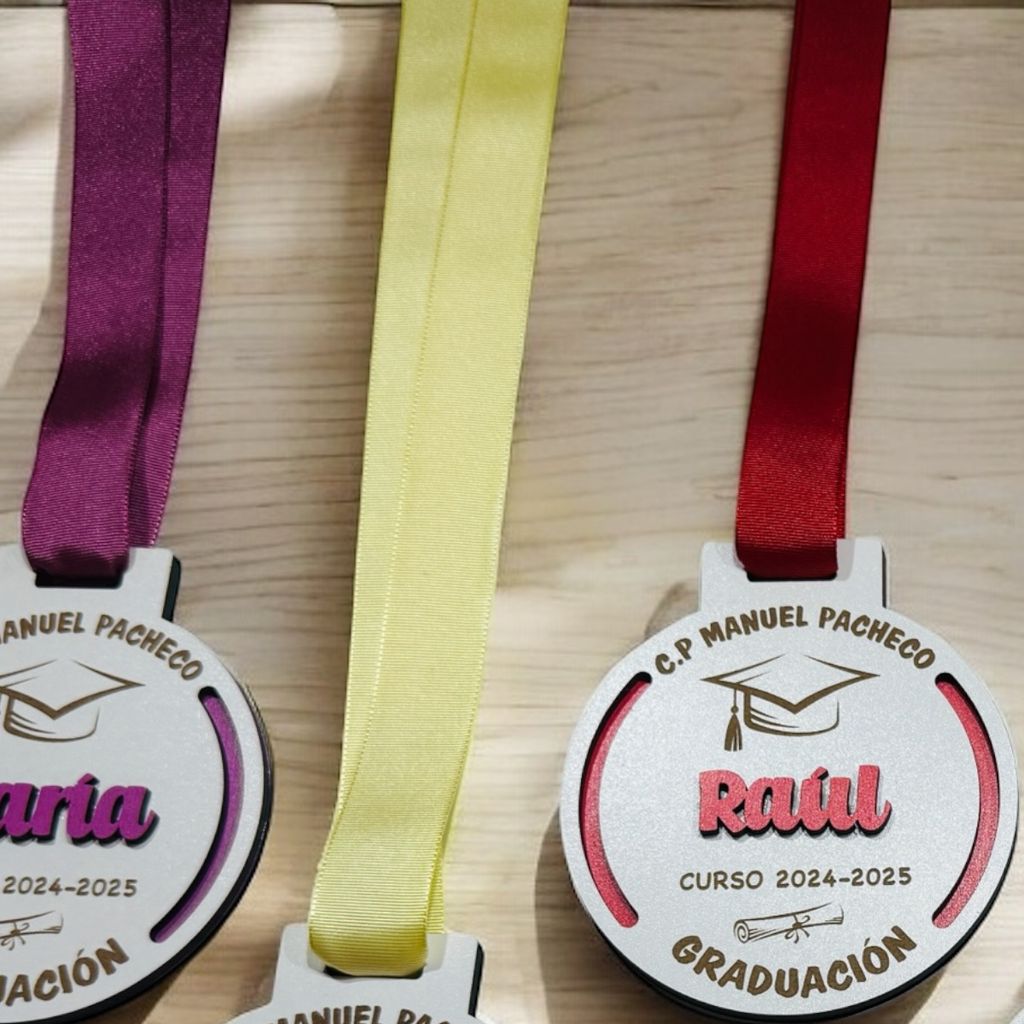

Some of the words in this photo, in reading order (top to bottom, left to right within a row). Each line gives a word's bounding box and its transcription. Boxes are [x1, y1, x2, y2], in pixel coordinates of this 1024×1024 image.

[0, 611, 85, 646] ANUEL
[94, 613, 202, 681] PACHECO
[654, 637, 693, 675] C.P
[700, 606, 809, 647] MANUEL
[818, 606, 937, 670] PACHECO
[698, 764, 892, 838] Raúl
[3, 876, 138, 897] 2024-2025
[679, 870, 764, 891] CURSO
[776, 867, 913, 888] 2024-2025
[672, 925, 917, 998] GRADUACIÓN
